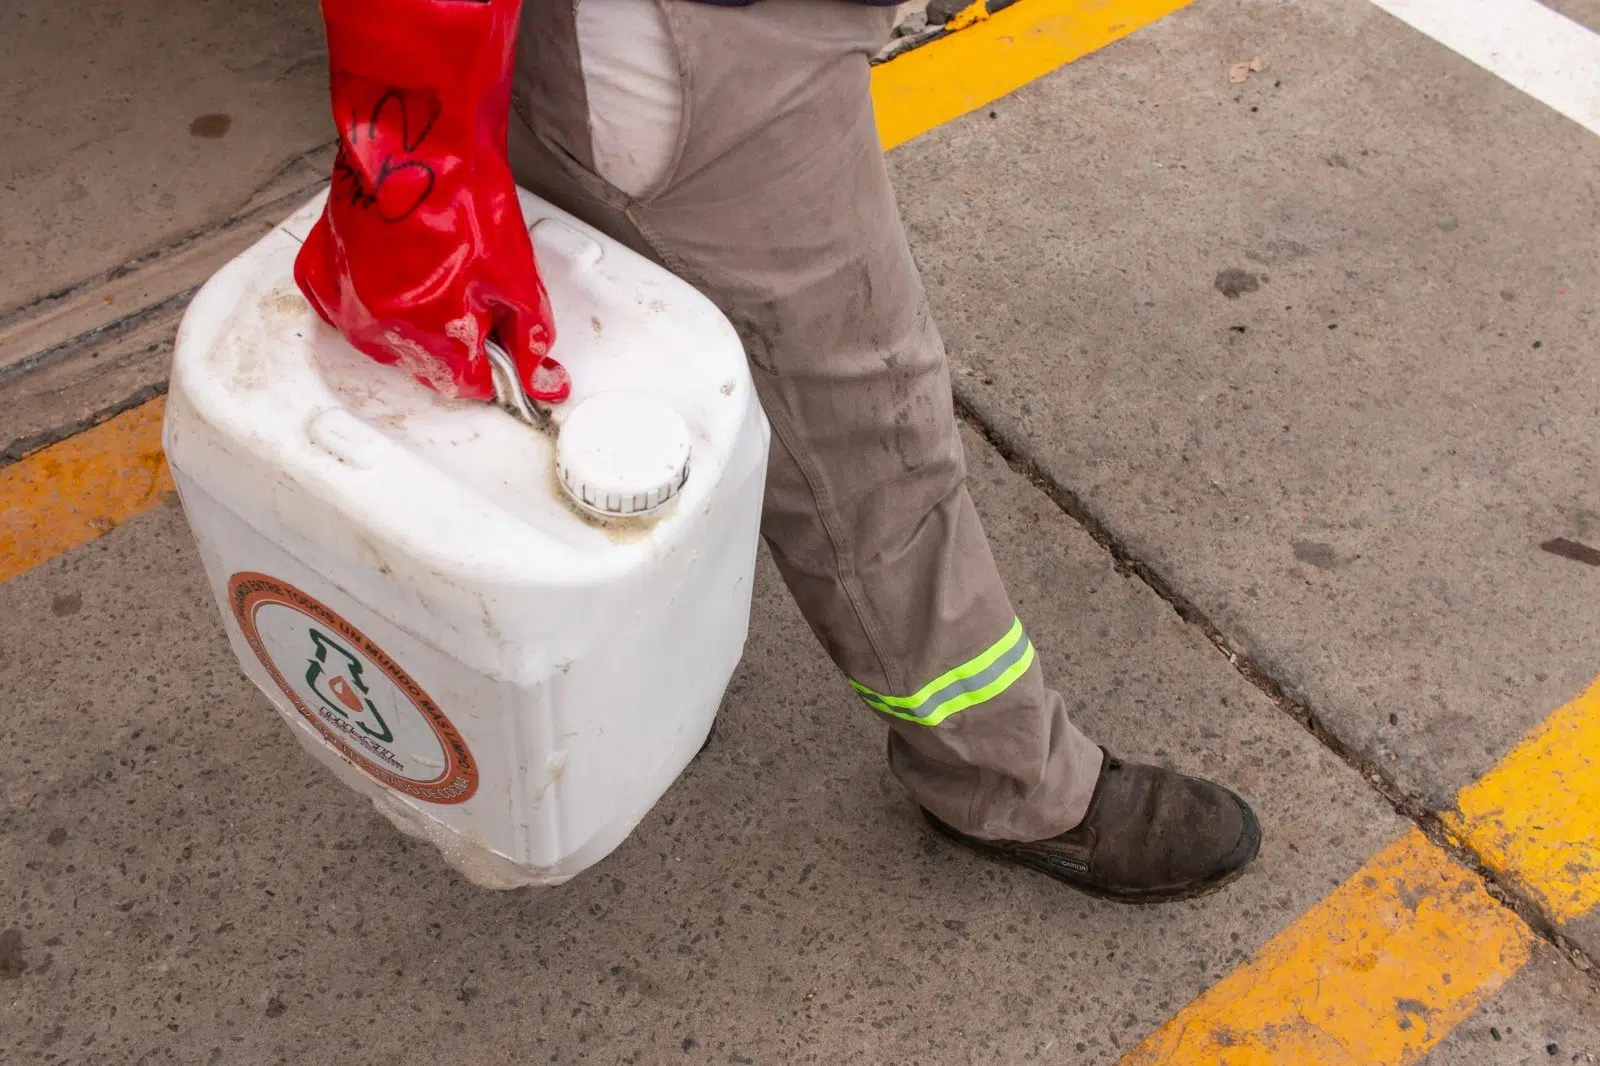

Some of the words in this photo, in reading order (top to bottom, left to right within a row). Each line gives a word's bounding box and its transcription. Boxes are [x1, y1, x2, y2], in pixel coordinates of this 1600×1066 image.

[283, 588, 335, 624] TODOS
[339, 621, 362, 644] UN
[364, 642, 421, 697] MUNDO
[436, 776, 470, 799] COCINA
